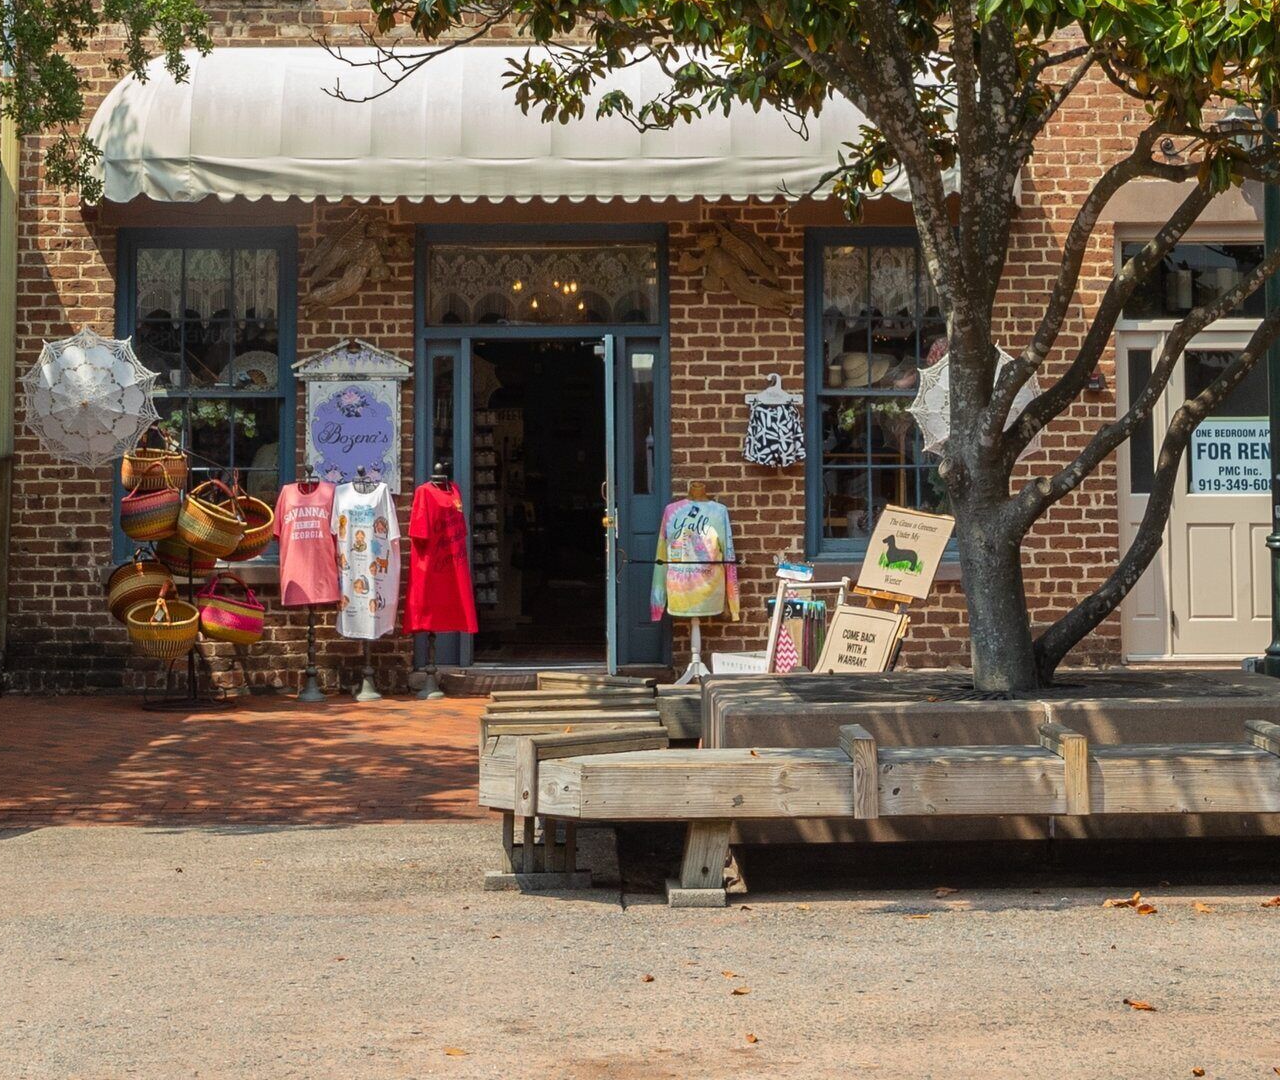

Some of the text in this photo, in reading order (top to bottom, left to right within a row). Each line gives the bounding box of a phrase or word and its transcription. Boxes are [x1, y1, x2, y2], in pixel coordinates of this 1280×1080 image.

[318, 421, 388, 453] Bozena's
[1195, 429, 1212, 438] ONE
[1214, 429, 1256, 438] BEDROOM
[1197, 442, 1271, 460] FOR REN
[1218, 466, 1262, 476] PMC Inc.
[1198, 478, 1272, 491] 919-349-60
[890, 517, 899, 526] The
[899, 520, 912, 529] Grass
[918, 522, 938, 533] Greener
[292, 530, 324, 540] GEORGIA
[896, 530, 921, 541] Under My
[842, 628, 877, 643] COME BACK
[846, 642, 868, 655] WITH A
[837, 653, 868, 668] WARRANT.
